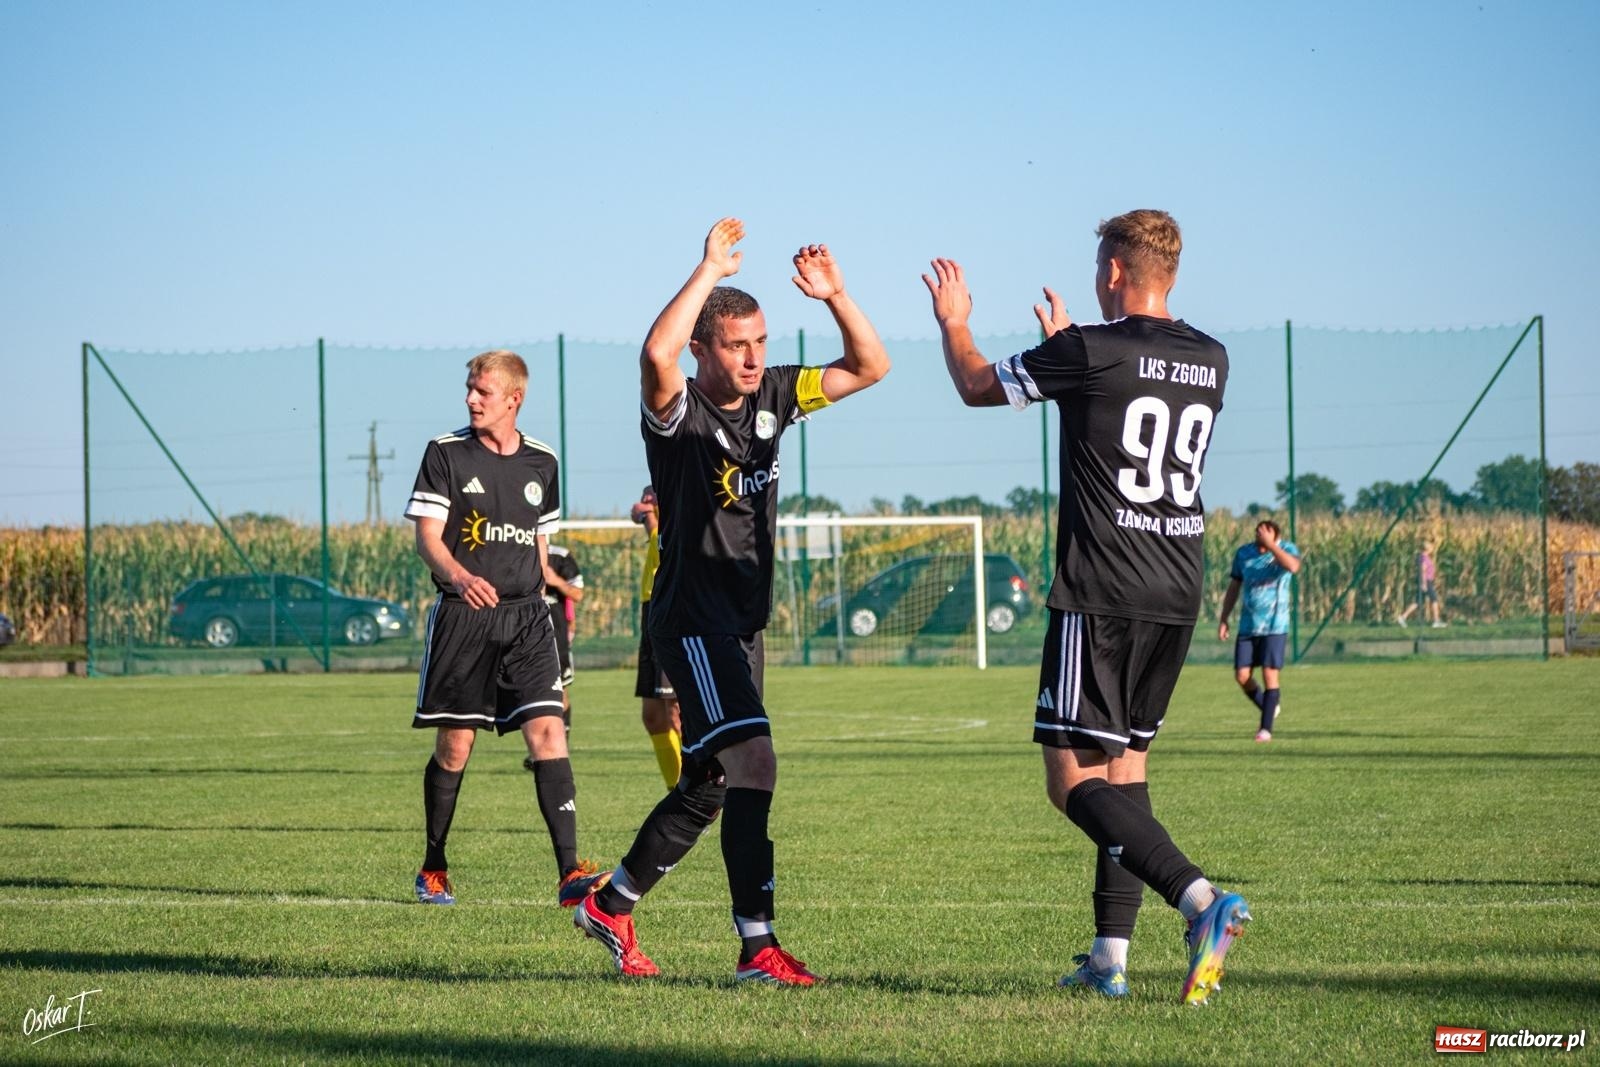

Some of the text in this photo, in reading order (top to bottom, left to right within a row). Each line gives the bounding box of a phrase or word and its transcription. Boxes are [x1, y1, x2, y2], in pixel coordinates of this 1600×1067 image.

[1139, 356, 1217, 389] LKS ZGODA
[1118, 396, 1213, 507] 99
[485, 521, 536, 546] InPost
